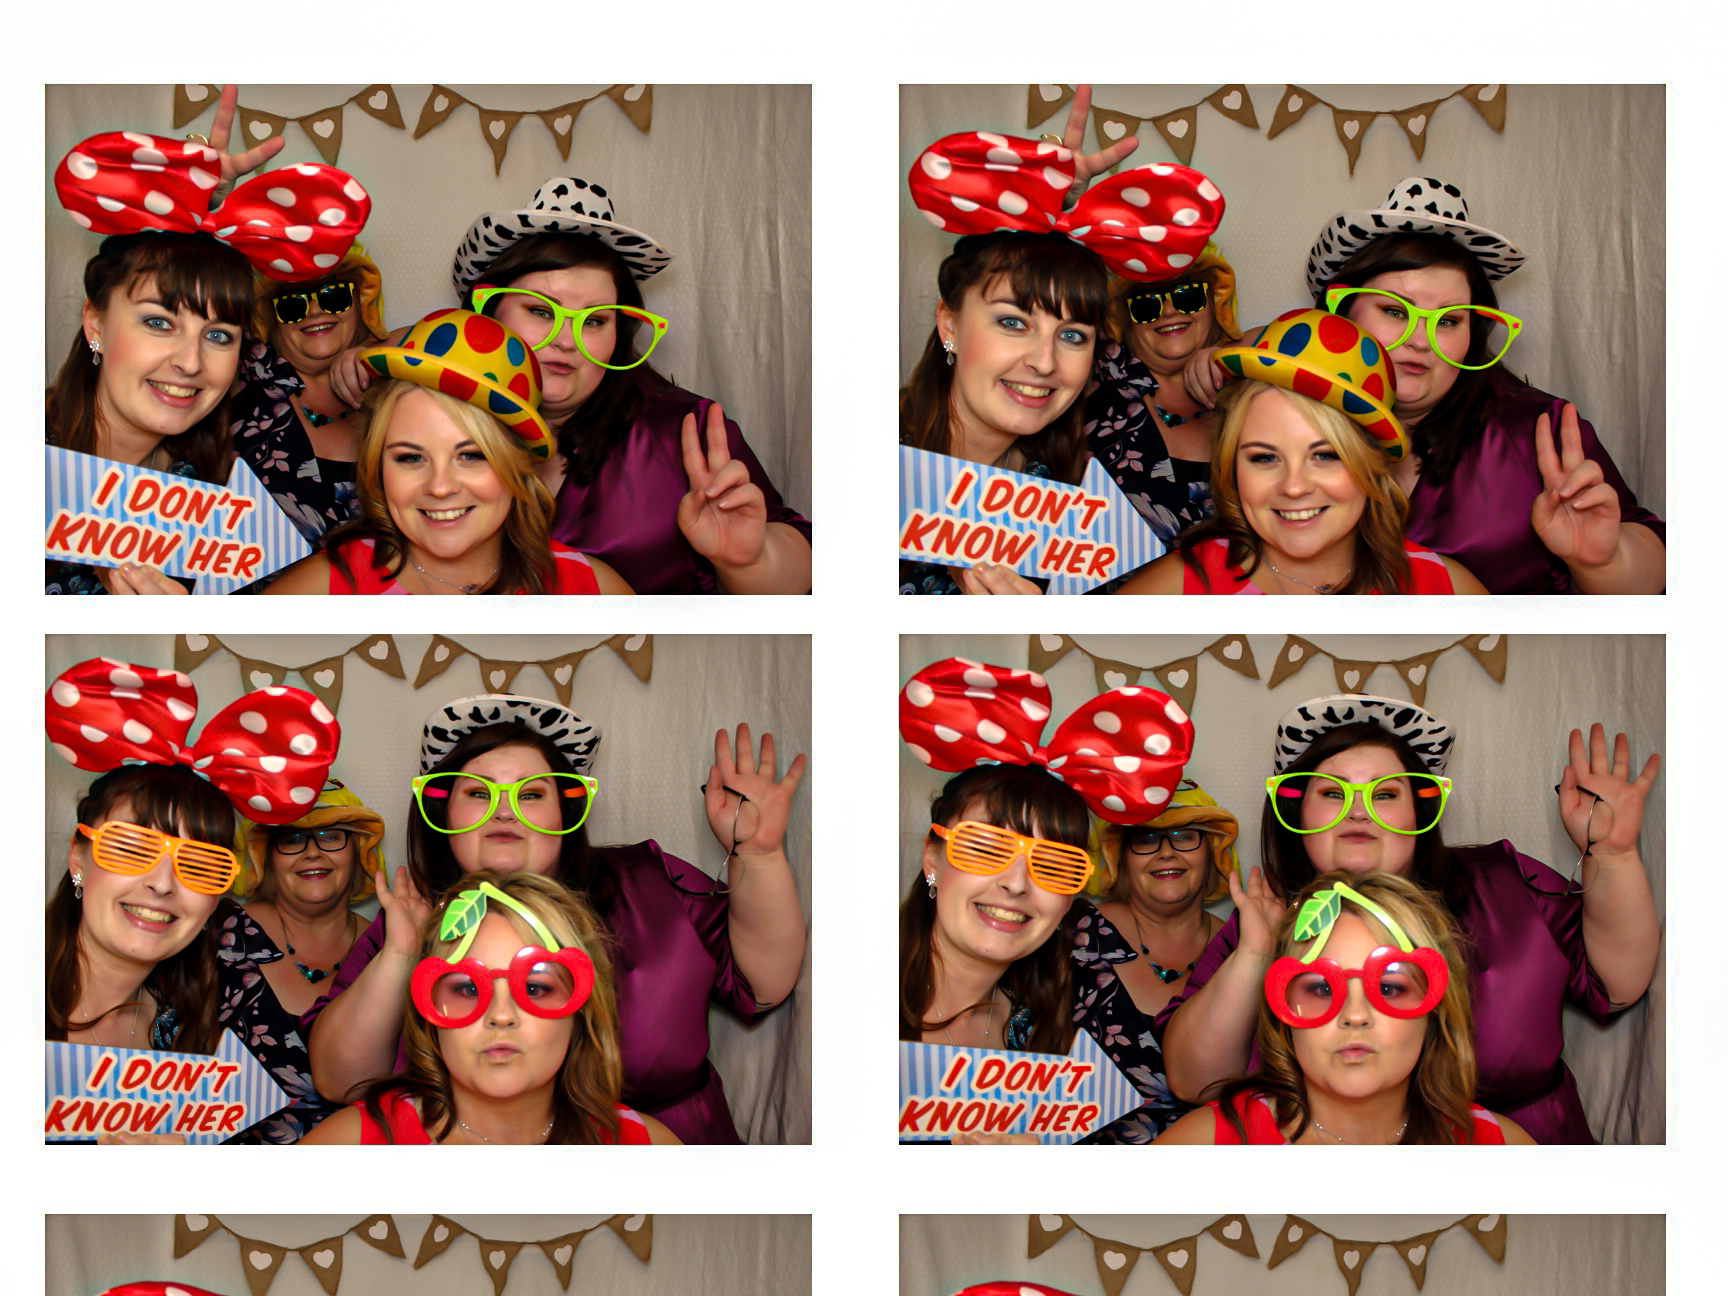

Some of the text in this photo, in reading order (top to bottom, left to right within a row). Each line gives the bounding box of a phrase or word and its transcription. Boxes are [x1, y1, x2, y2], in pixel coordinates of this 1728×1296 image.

[96, 472, 252, 530] I DON'T
[950, 472, 1106, 530] I DON'T
[47, 514, 262, 578] KNOW HER
[901, 514, 1116, 578] KNOW HER
[91, 1056, 238, 1093] I DON'T
[945, 1056, 1092, 1093] I DON'T
[45, 1100, 244, 1132] KNOW HER
[899, 1100, 1098, 1132] KNOW HER
